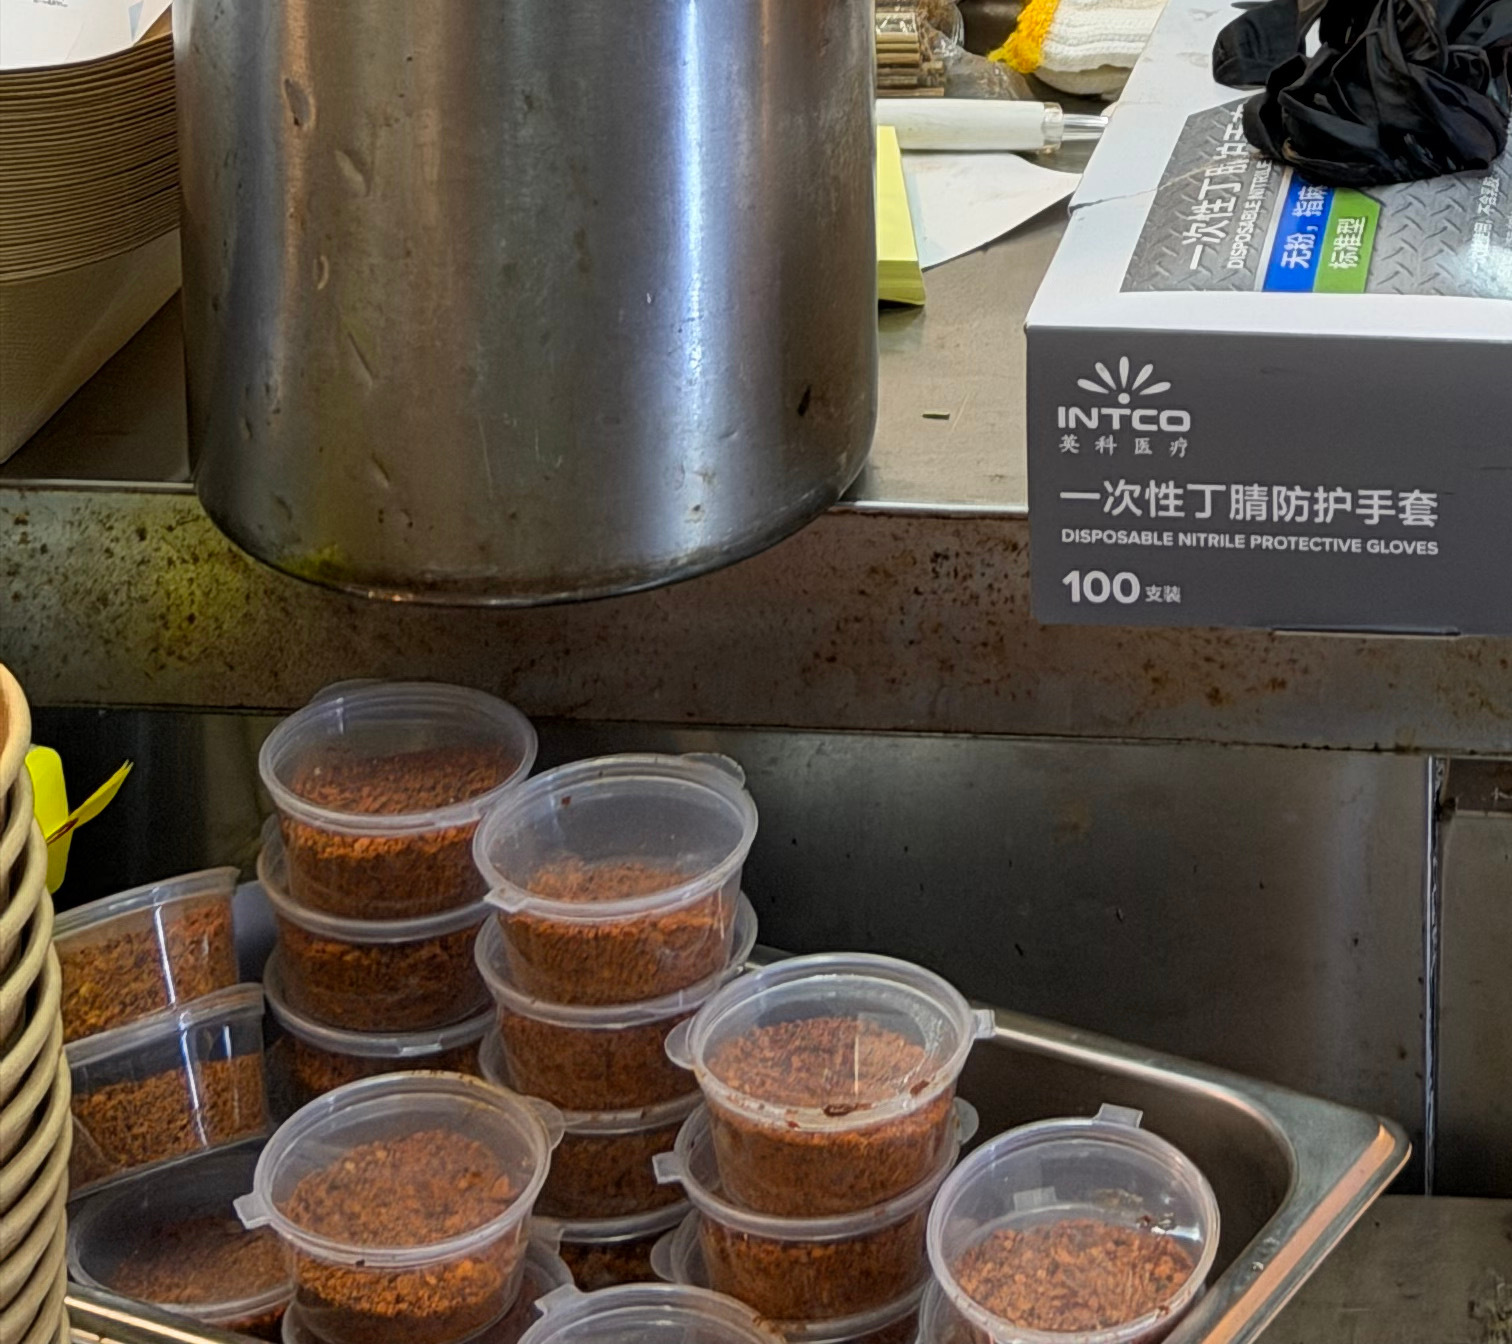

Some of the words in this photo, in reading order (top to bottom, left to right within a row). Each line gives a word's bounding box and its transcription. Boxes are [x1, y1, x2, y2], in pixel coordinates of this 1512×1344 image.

[1181, 103, 1250, 270] 一次性丁护手
[1227, 199, 1262, 270] DISPOSABLE
[1328, 216, 1367, 268] 标准型
[1057, 406, 1191, 432] INTCO
[1059, 435, 1188, 458] 英科医疗
[1060, 478, 1439, 527] 一次性丁腈防护手套
[1061, 528, 1174, 546] DISPOSABLE
[1178, 533, 1246, 549] NITRILE
[1250, 535, 1362, 553] PROTECTIVE
[1366, 539, 1439, 555] GLOVES
[1062, 570, 1140, 604] 100
[1145, 584, 1181, 603] 支装
